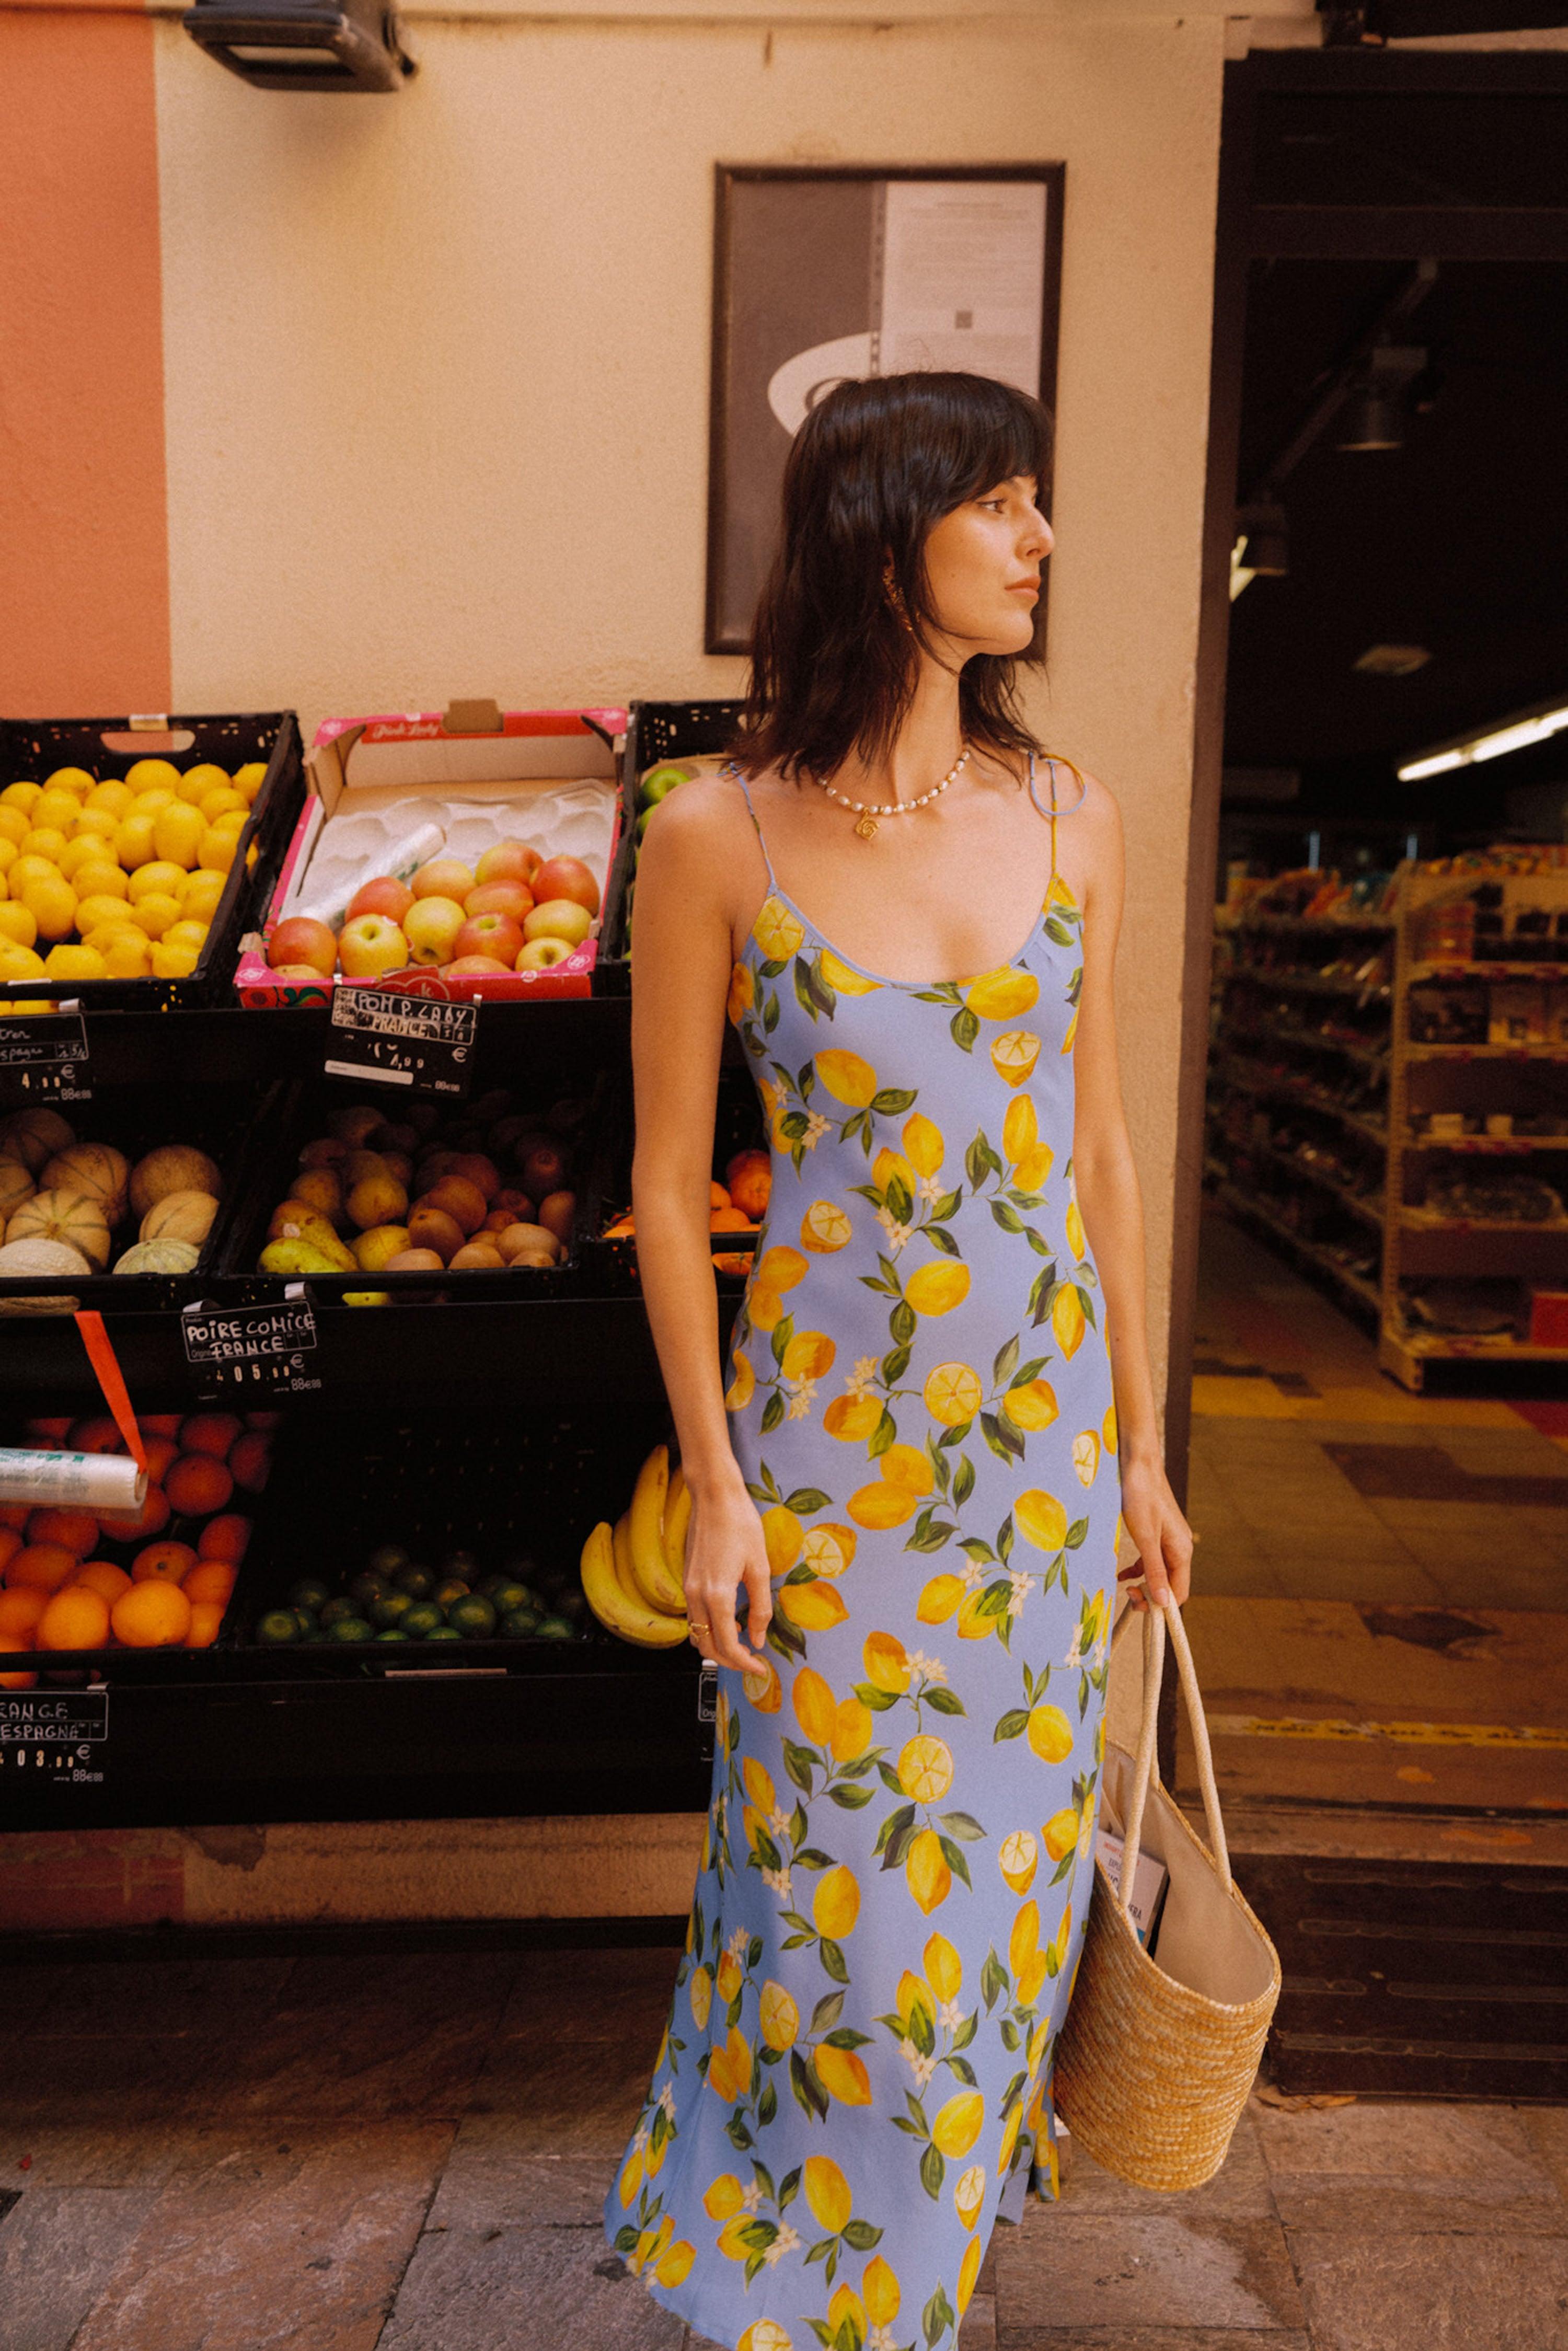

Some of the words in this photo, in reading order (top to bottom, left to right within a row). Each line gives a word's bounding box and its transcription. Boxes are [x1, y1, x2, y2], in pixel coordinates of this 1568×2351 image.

[372, 1016, 428, 1037] FRANCE
[209, 1335, 285, 1362] FRANCE
[1, 1723, 80, 1740] ESPAGNE
